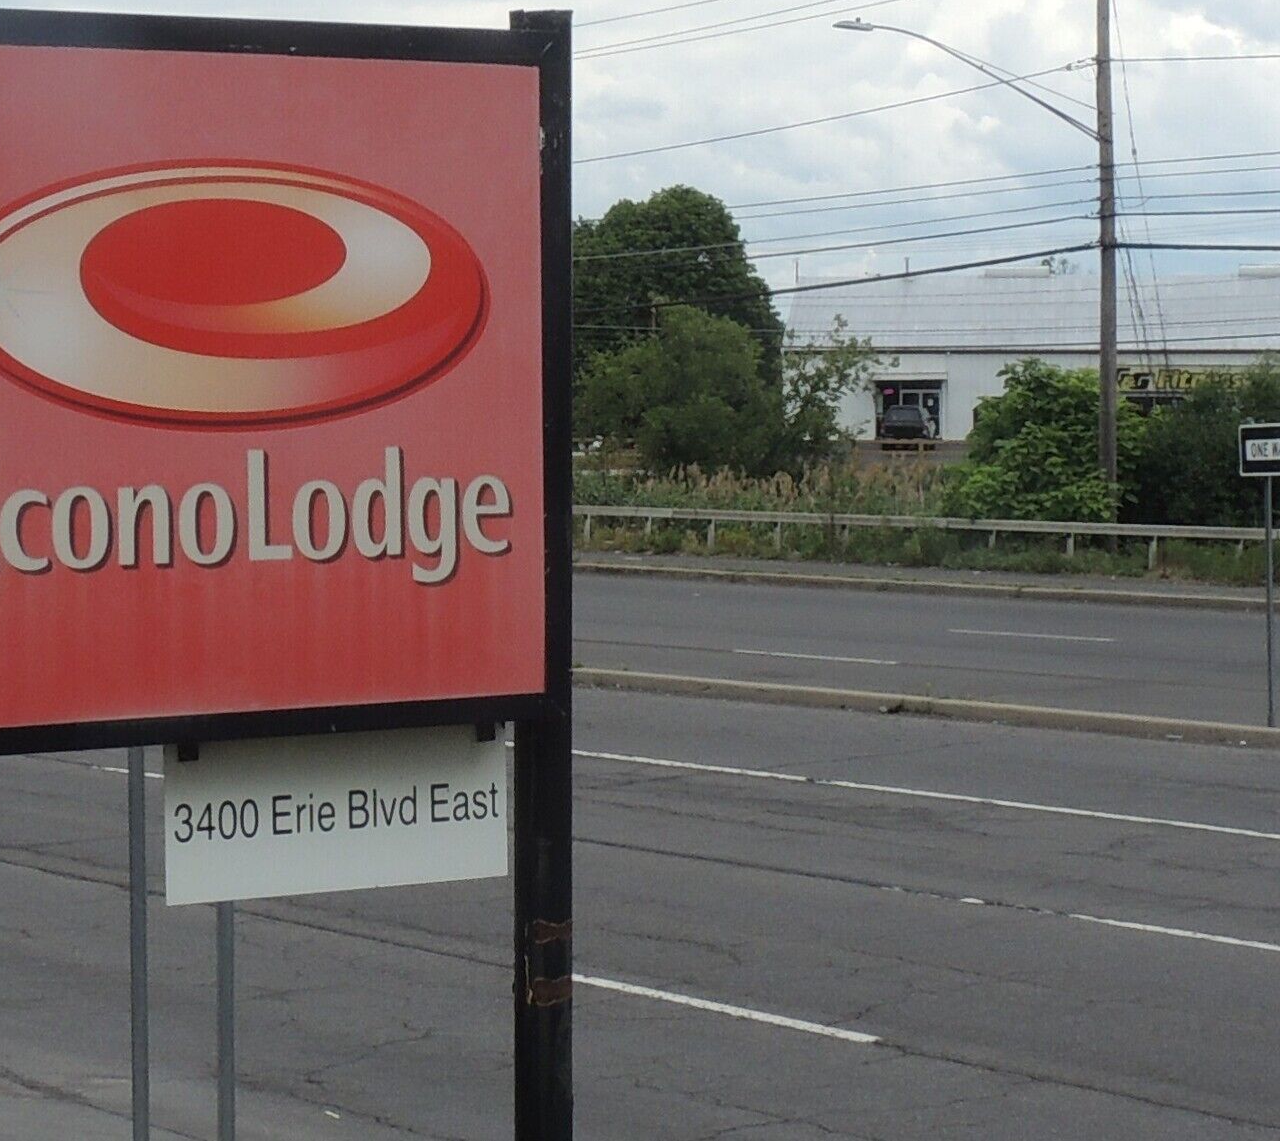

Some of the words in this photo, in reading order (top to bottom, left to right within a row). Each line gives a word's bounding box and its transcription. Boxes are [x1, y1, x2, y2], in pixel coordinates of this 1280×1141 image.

[1250, 442, 1269, 458] ONE
[173, 798, 260, 844] 3400
[272, 793, 337, 836] Erie
[348, 785, 418, 830] Blvd
[430, 782, 500, 824] East
